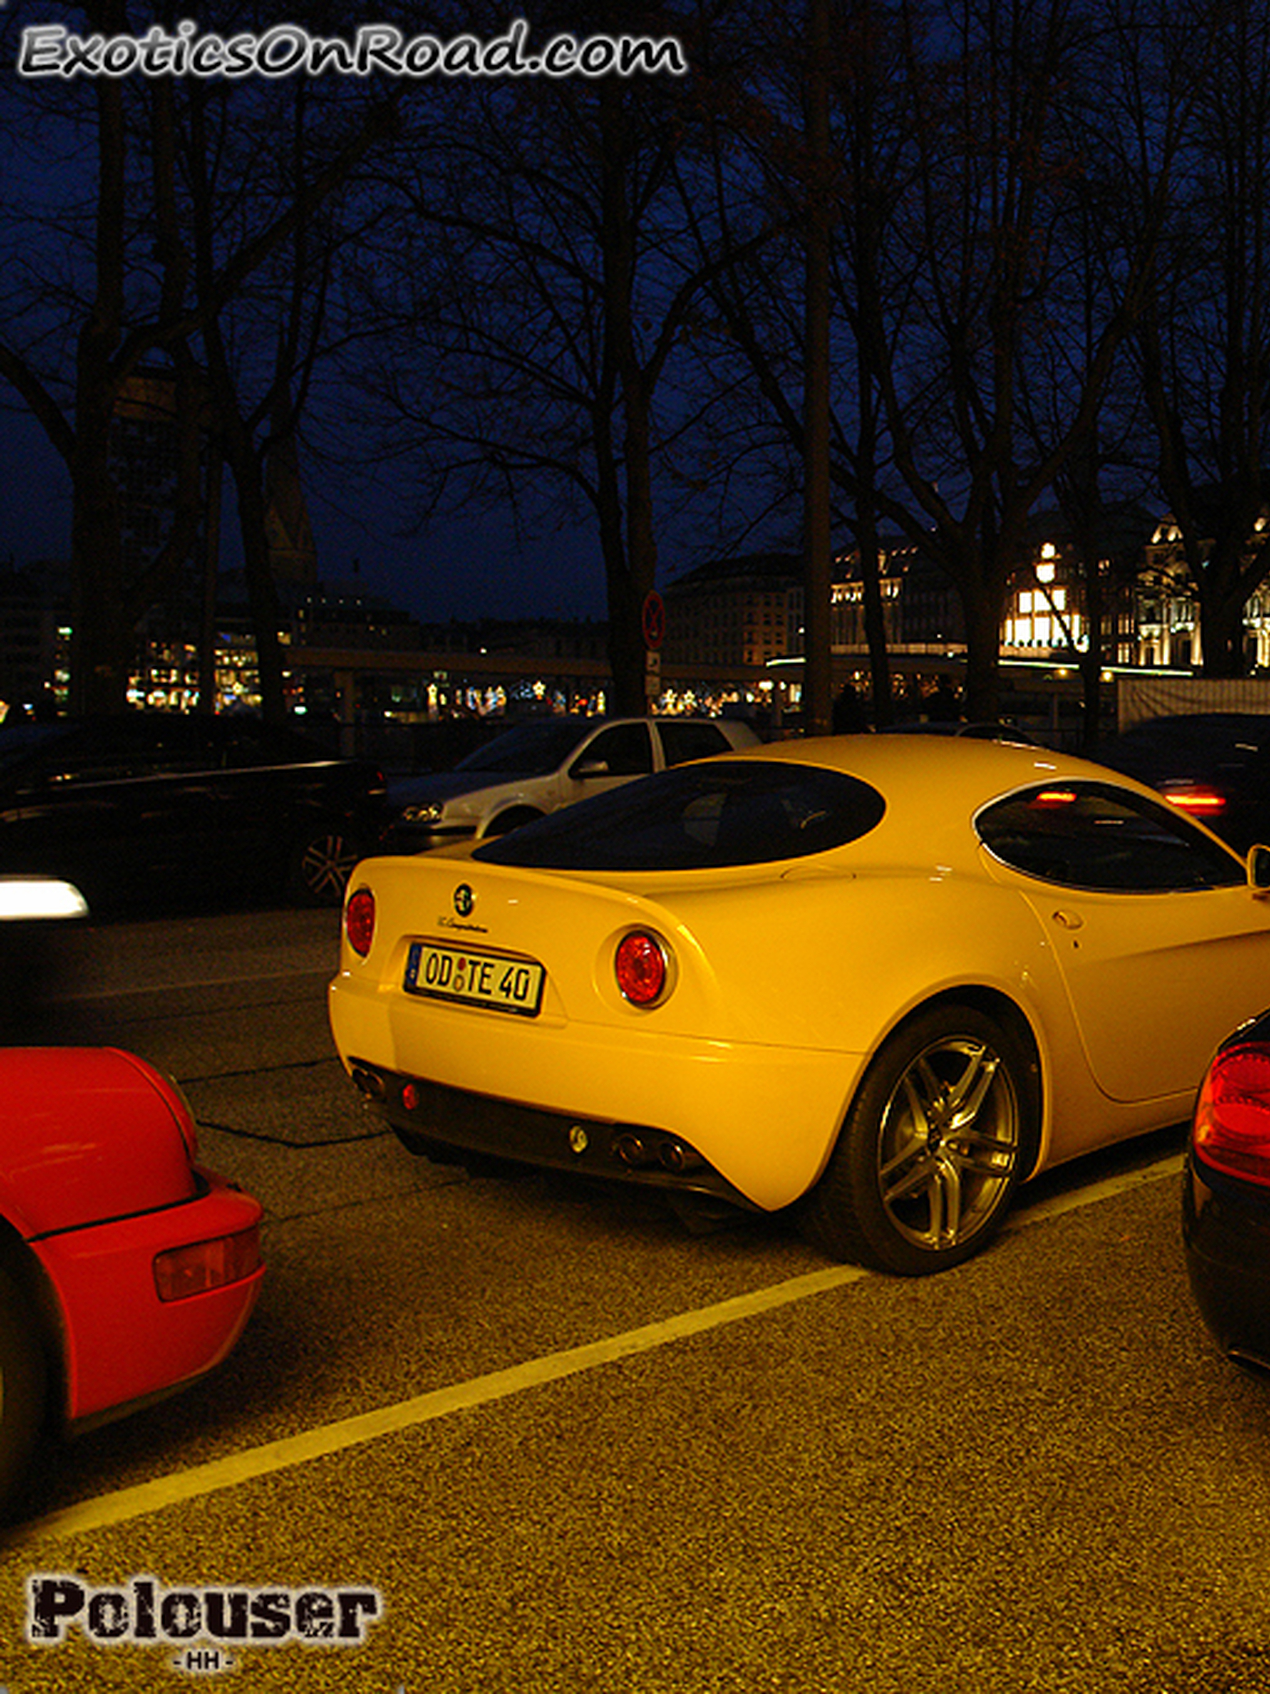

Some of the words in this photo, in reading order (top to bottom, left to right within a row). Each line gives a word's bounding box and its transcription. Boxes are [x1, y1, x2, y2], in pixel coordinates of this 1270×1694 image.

[425, 952, 453, 986] OD
[468, 960, 495, 995] TE
[499, 966, 530, 1001] 40
